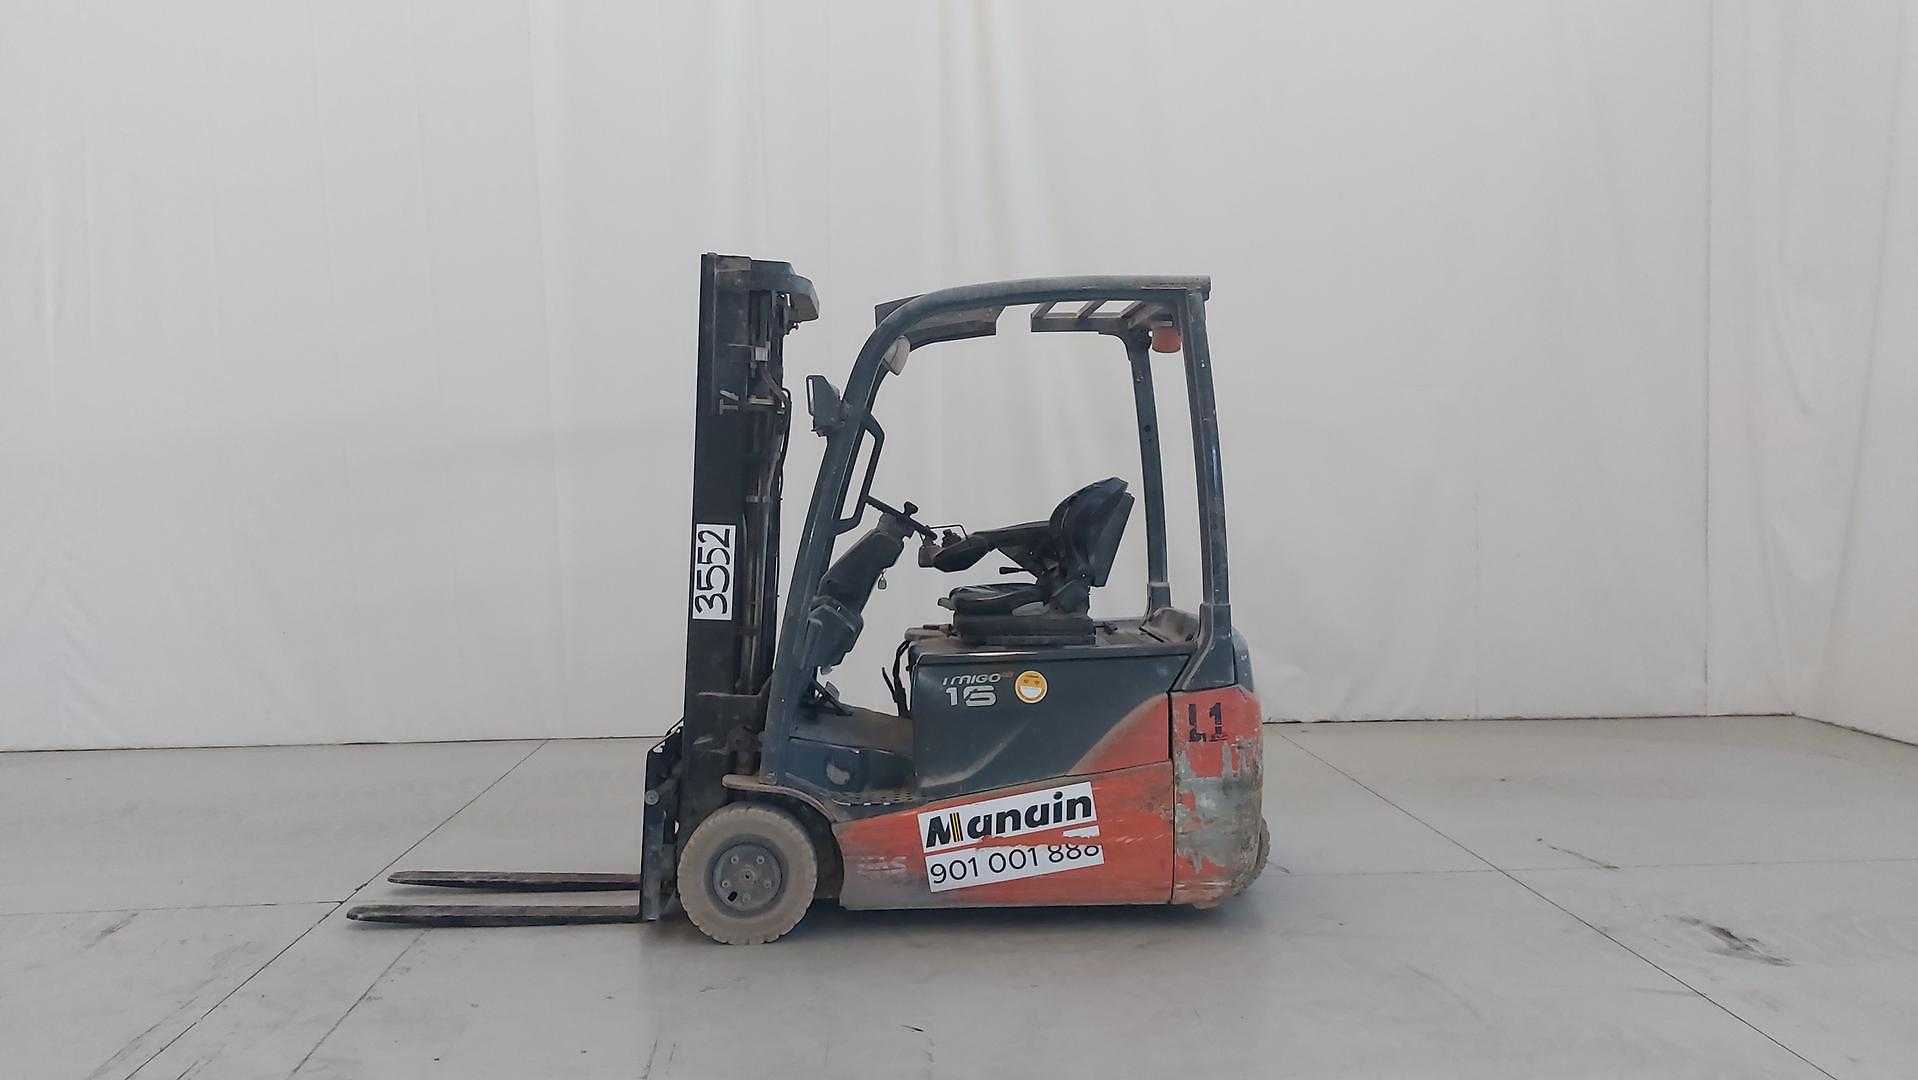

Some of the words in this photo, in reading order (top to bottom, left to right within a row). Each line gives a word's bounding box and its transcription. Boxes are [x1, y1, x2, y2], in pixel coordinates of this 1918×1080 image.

[694, 527, 731, 614] 3552
[945, 685, 997, 707] 16
[929, 856, 979, 884] 901
[988, 847, 1039, 874] 001
